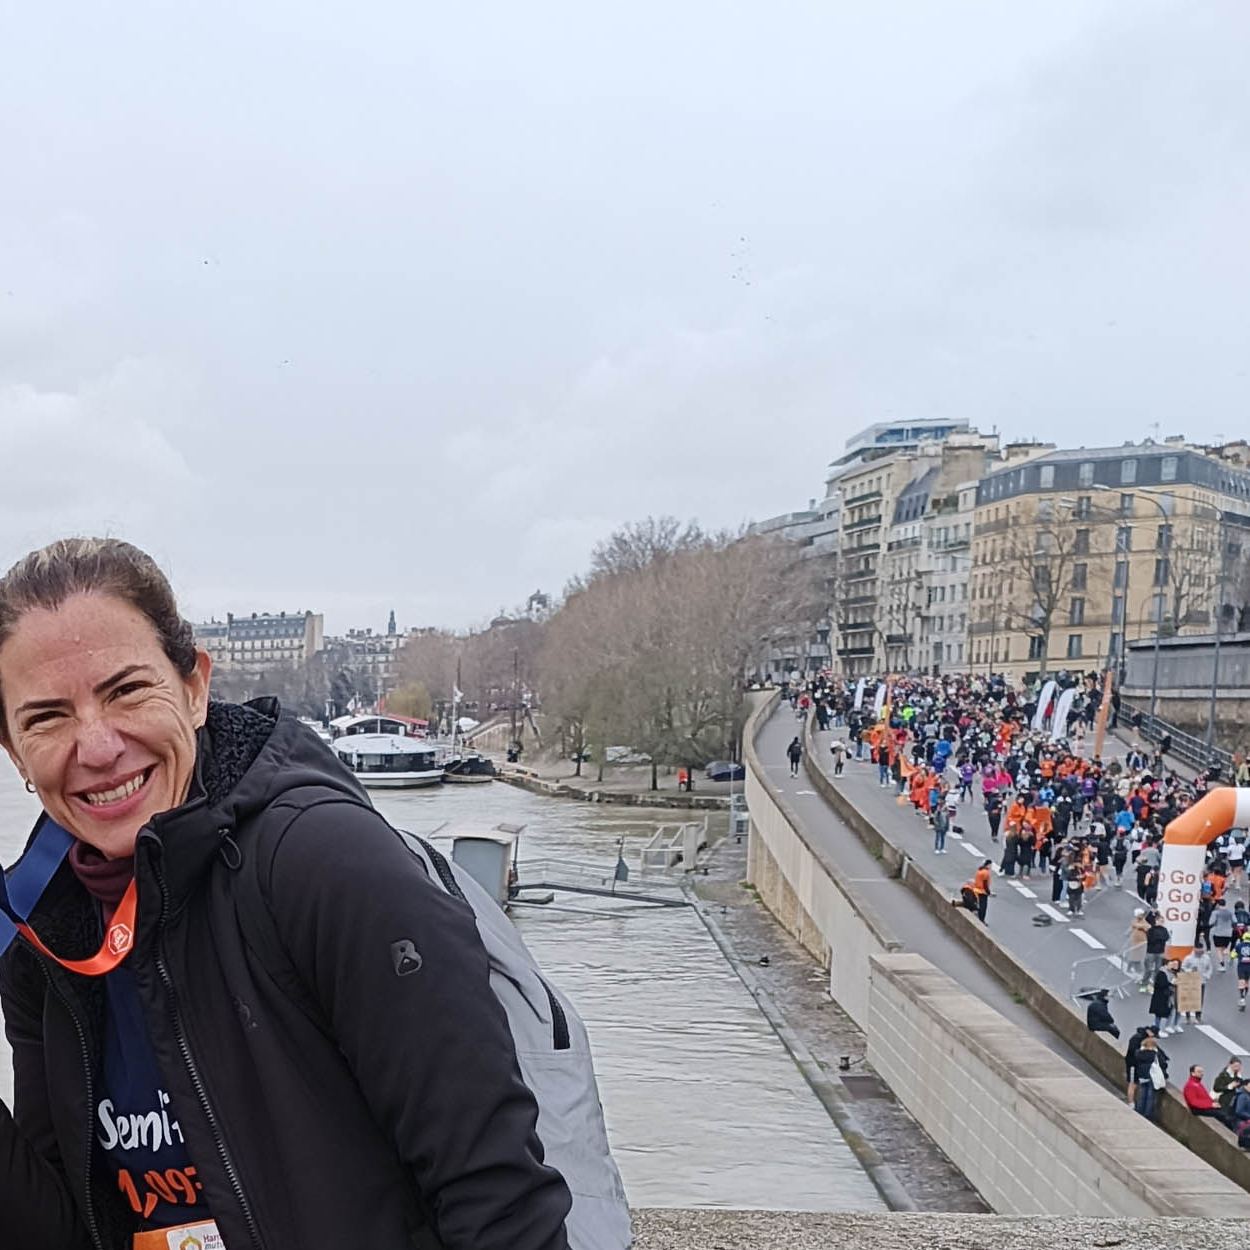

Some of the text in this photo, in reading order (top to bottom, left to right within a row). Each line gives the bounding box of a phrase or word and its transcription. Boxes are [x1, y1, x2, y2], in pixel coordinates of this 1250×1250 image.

[1170, 870, 1196, 884] Go
[1168, 889, 1193, 903] Go
[1165, 907, 1191, 922] Go
